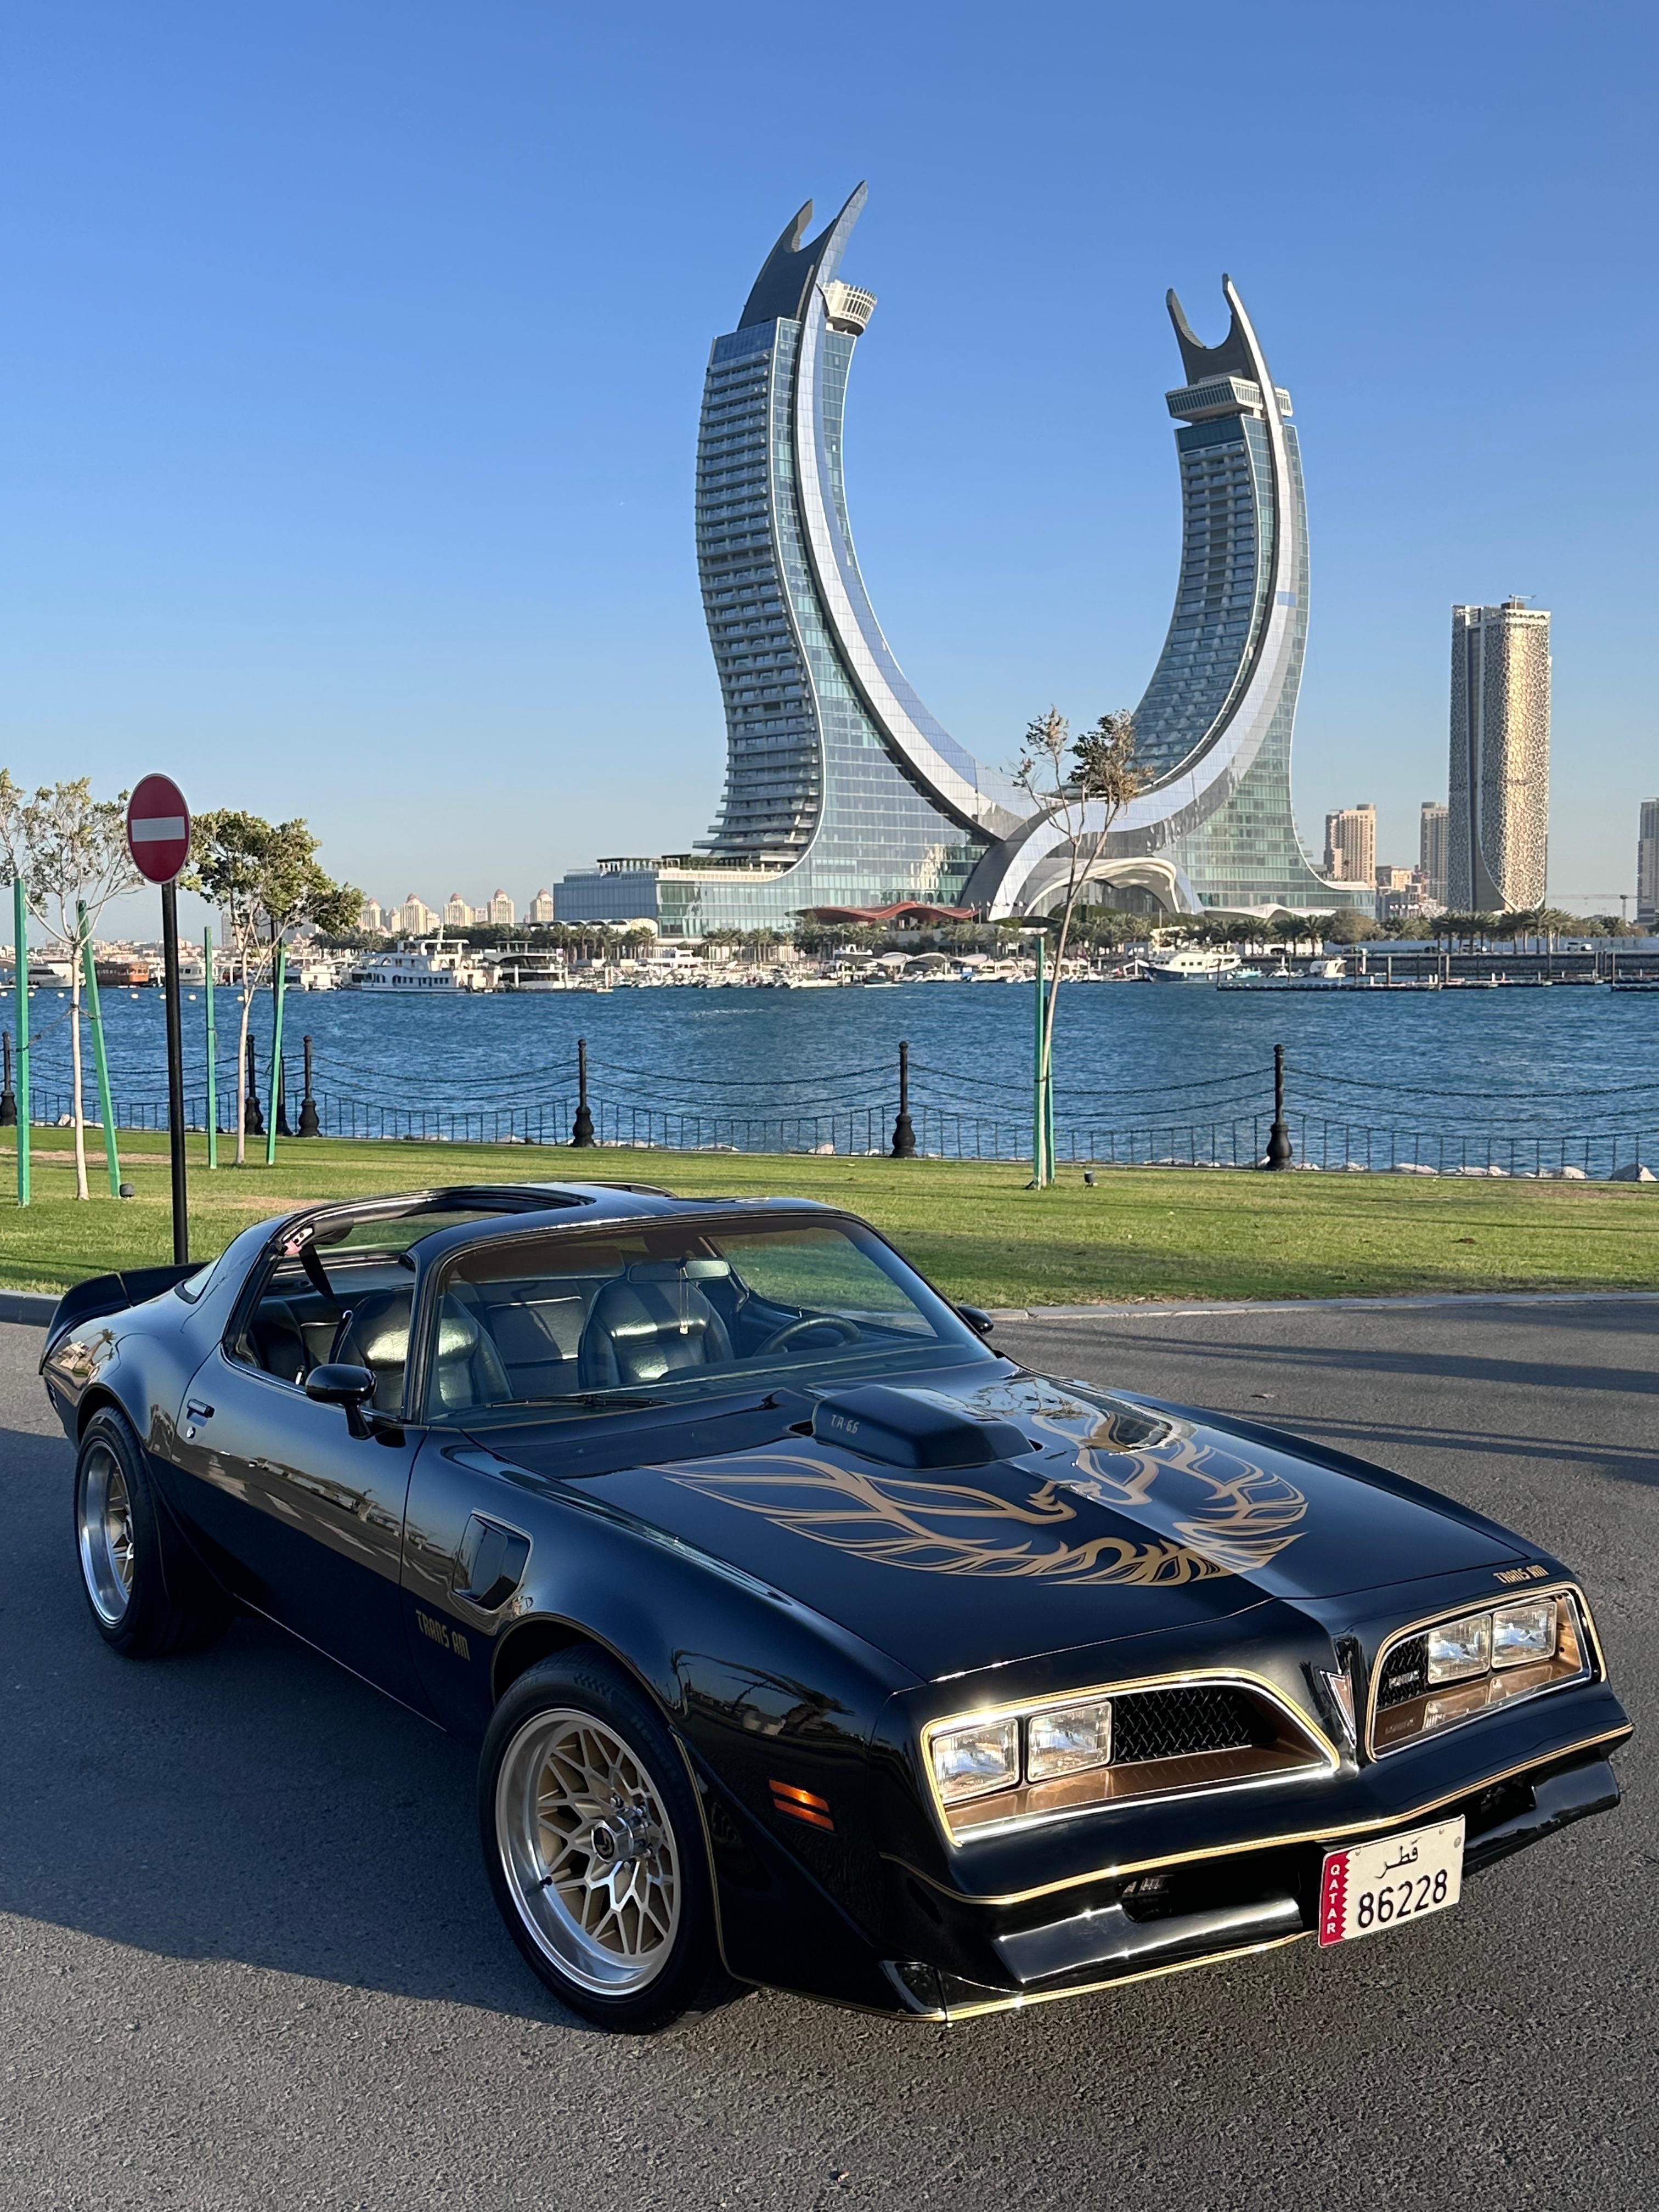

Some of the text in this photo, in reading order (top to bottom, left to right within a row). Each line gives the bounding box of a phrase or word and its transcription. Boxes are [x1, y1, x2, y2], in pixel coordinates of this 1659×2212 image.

[1492, 1567, 1531, 1584] TRANS
[415, 1609, 471, 1662] TRANS AM
[1374, 1836, 1423, 1879] قطر
[1327, 1864, 1340, 1934] QATAR
[1357, 1869, 1448, 1928] 86228
